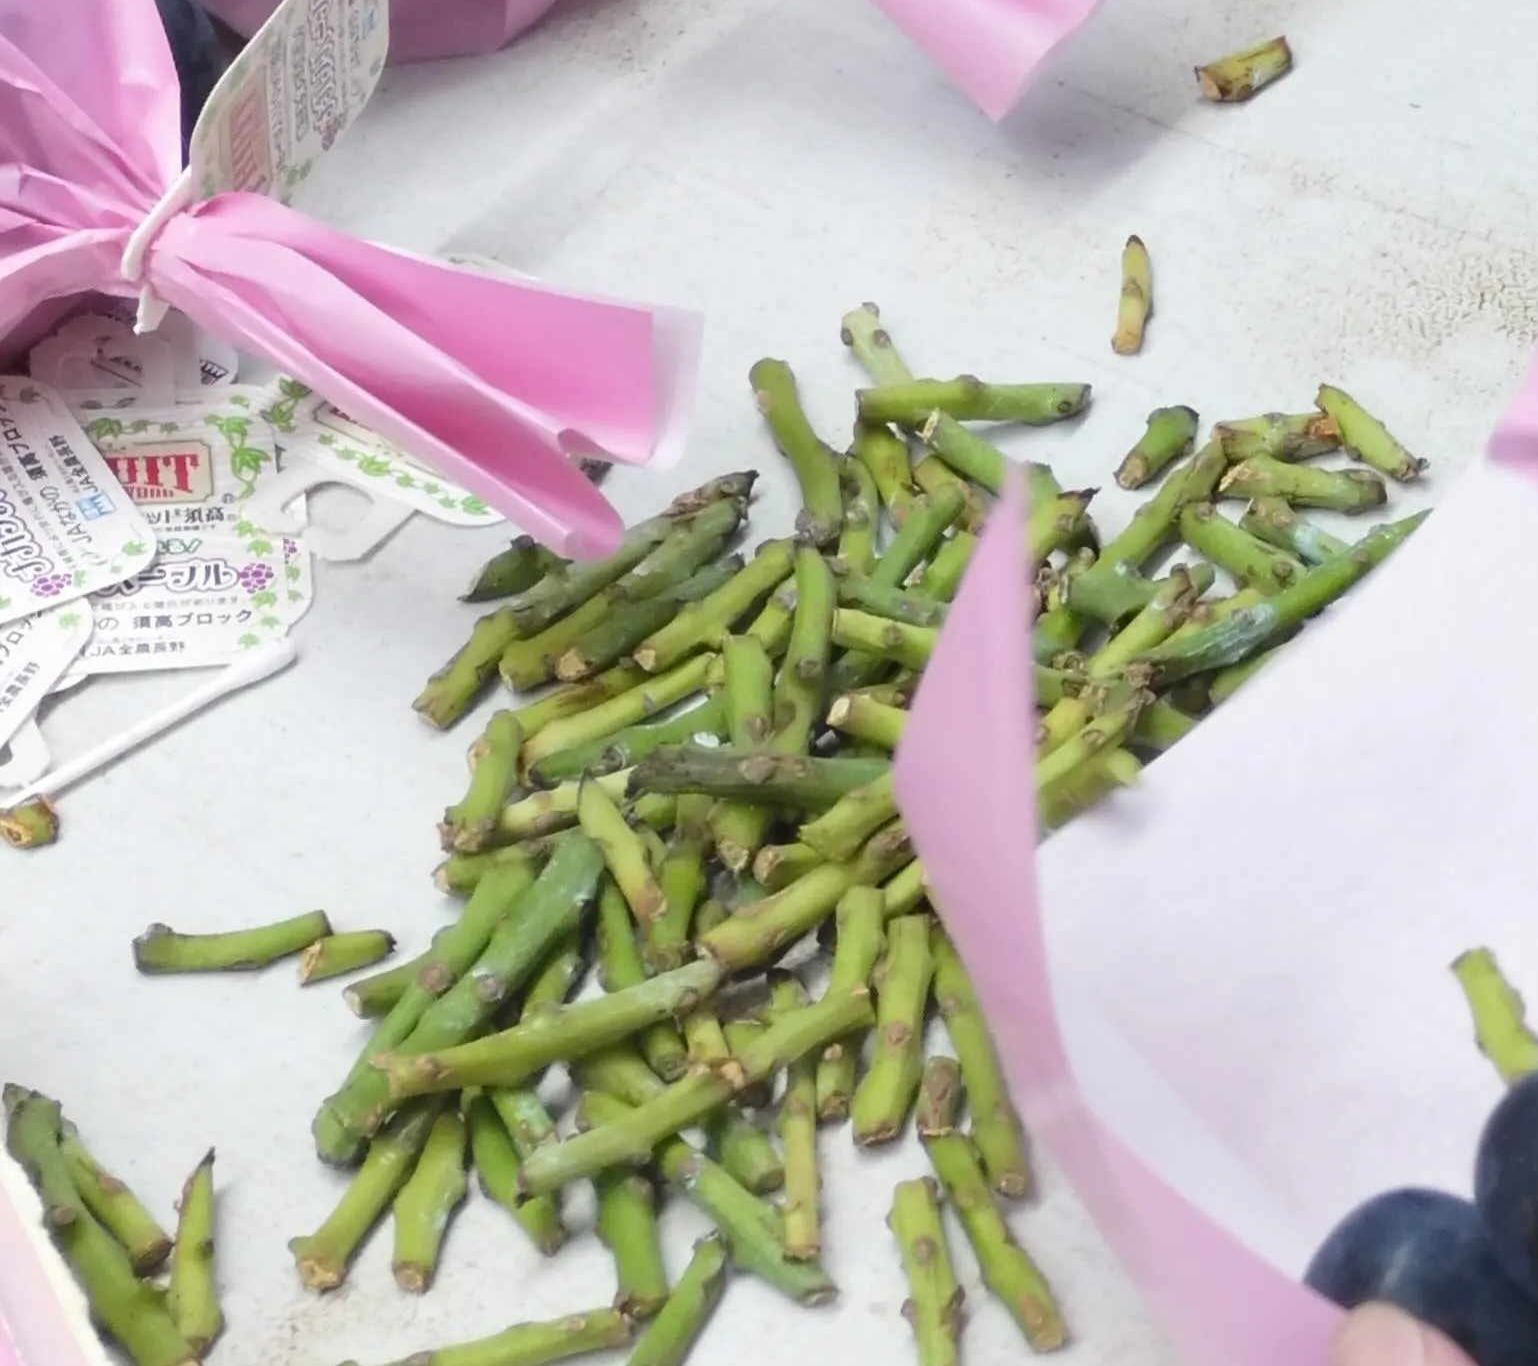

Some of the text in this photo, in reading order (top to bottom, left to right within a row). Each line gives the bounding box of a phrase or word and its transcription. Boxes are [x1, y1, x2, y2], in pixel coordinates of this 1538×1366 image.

[105, 454, 199, 494] UIT
[40, 485, 92, 543] JAながの
[132, 609, 253, 630] 須高ブロック
[90, 641, 186, 657] JA全農長野
